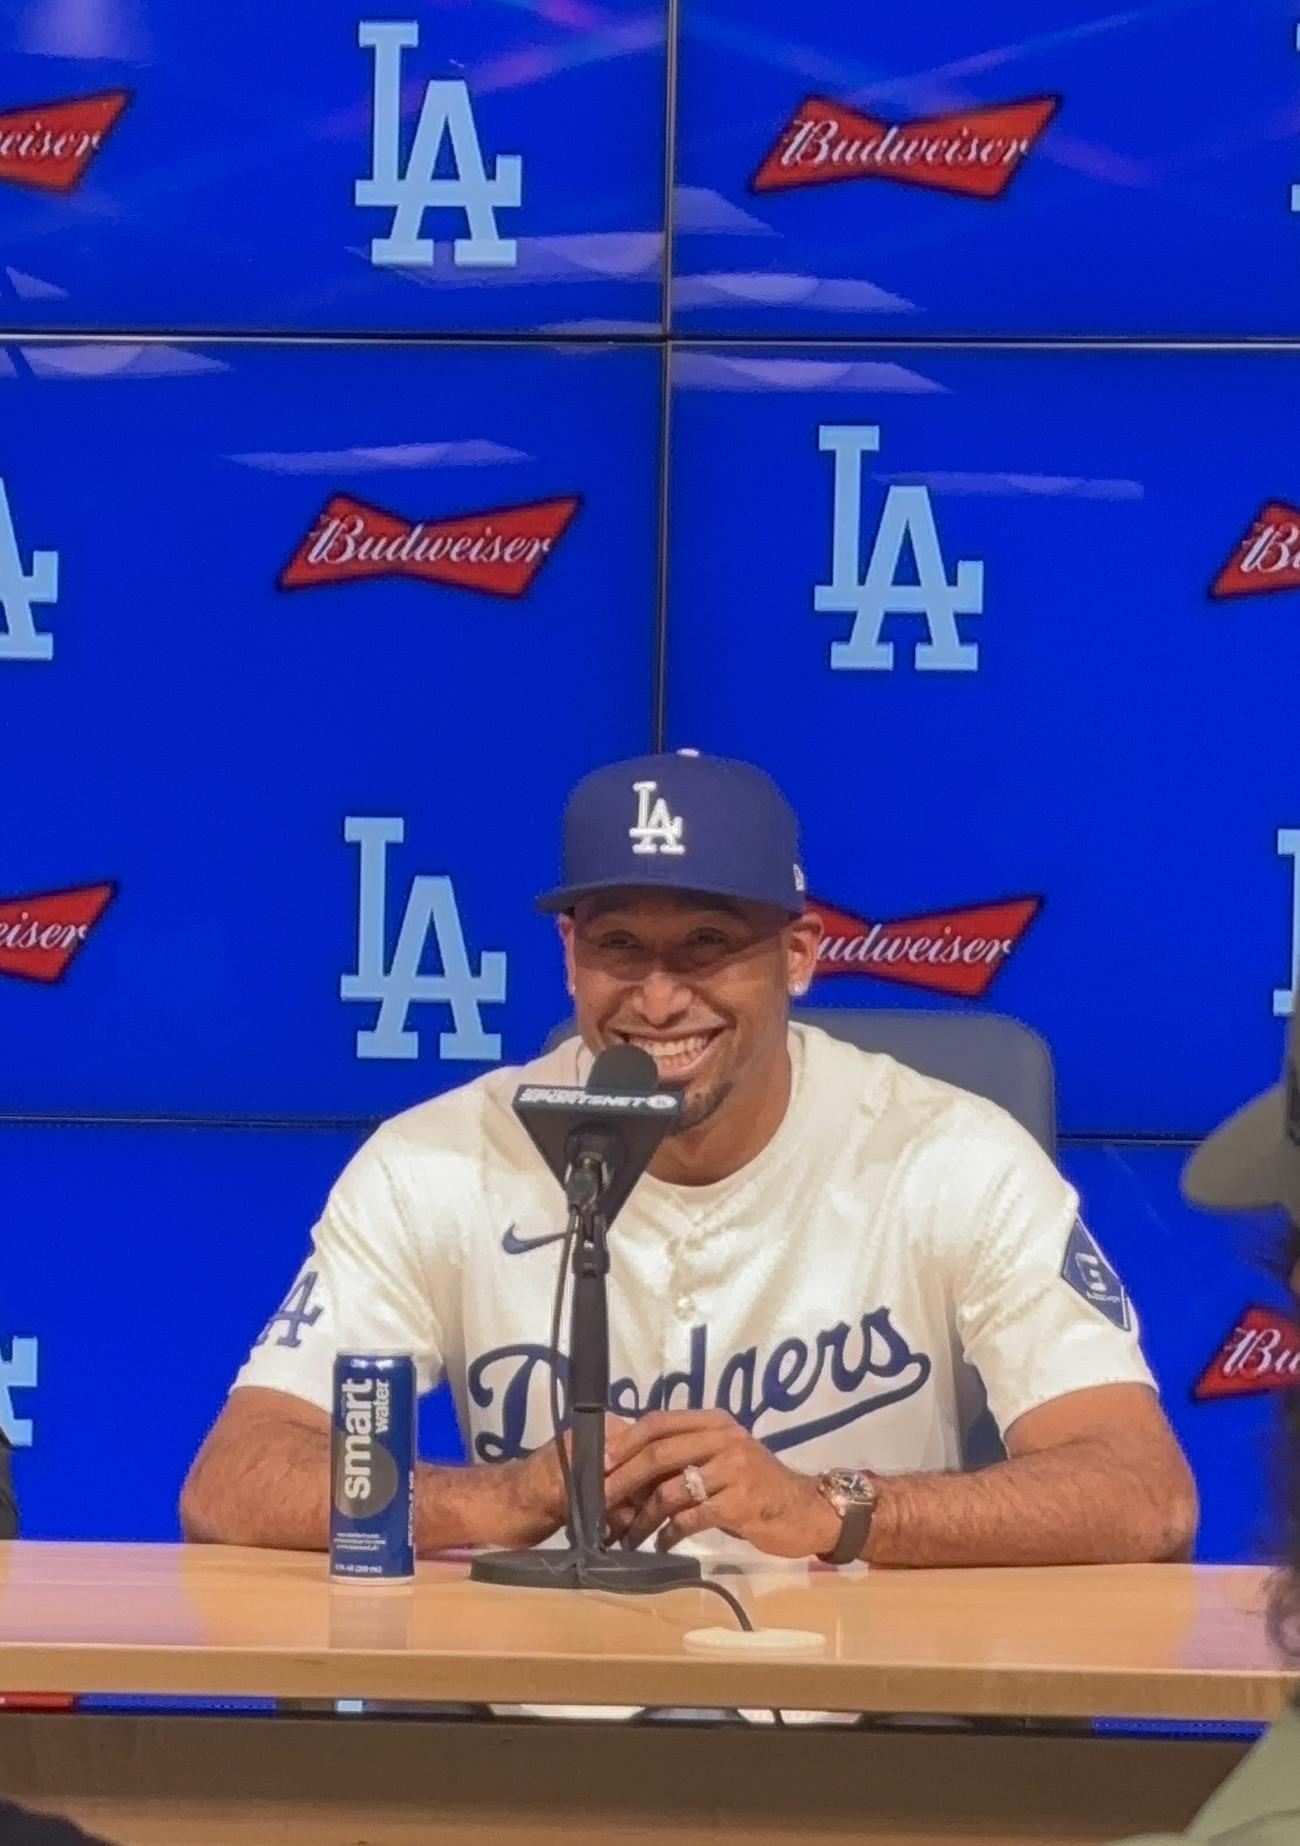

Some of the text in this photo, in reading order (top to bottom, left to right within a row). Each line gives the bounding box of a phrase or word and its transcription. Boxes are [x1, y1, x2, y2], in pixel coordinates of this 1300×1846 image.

[354, 20, 522, 267] LA
[781, 118, 1029, 166] Budweiser
[308, 514, 550, 564] Budweiser
[814, 425, 984, 671] LA
[629, 781, 685, 856] LA
[340, 816, 507, 1060] LA
[816, 923, 1012, 964] udweiser
[374, 1378, 390, 1434] water
[468, 1305, 932, 1464] Dodgers
[342, 1378, 373, 1500] smart
